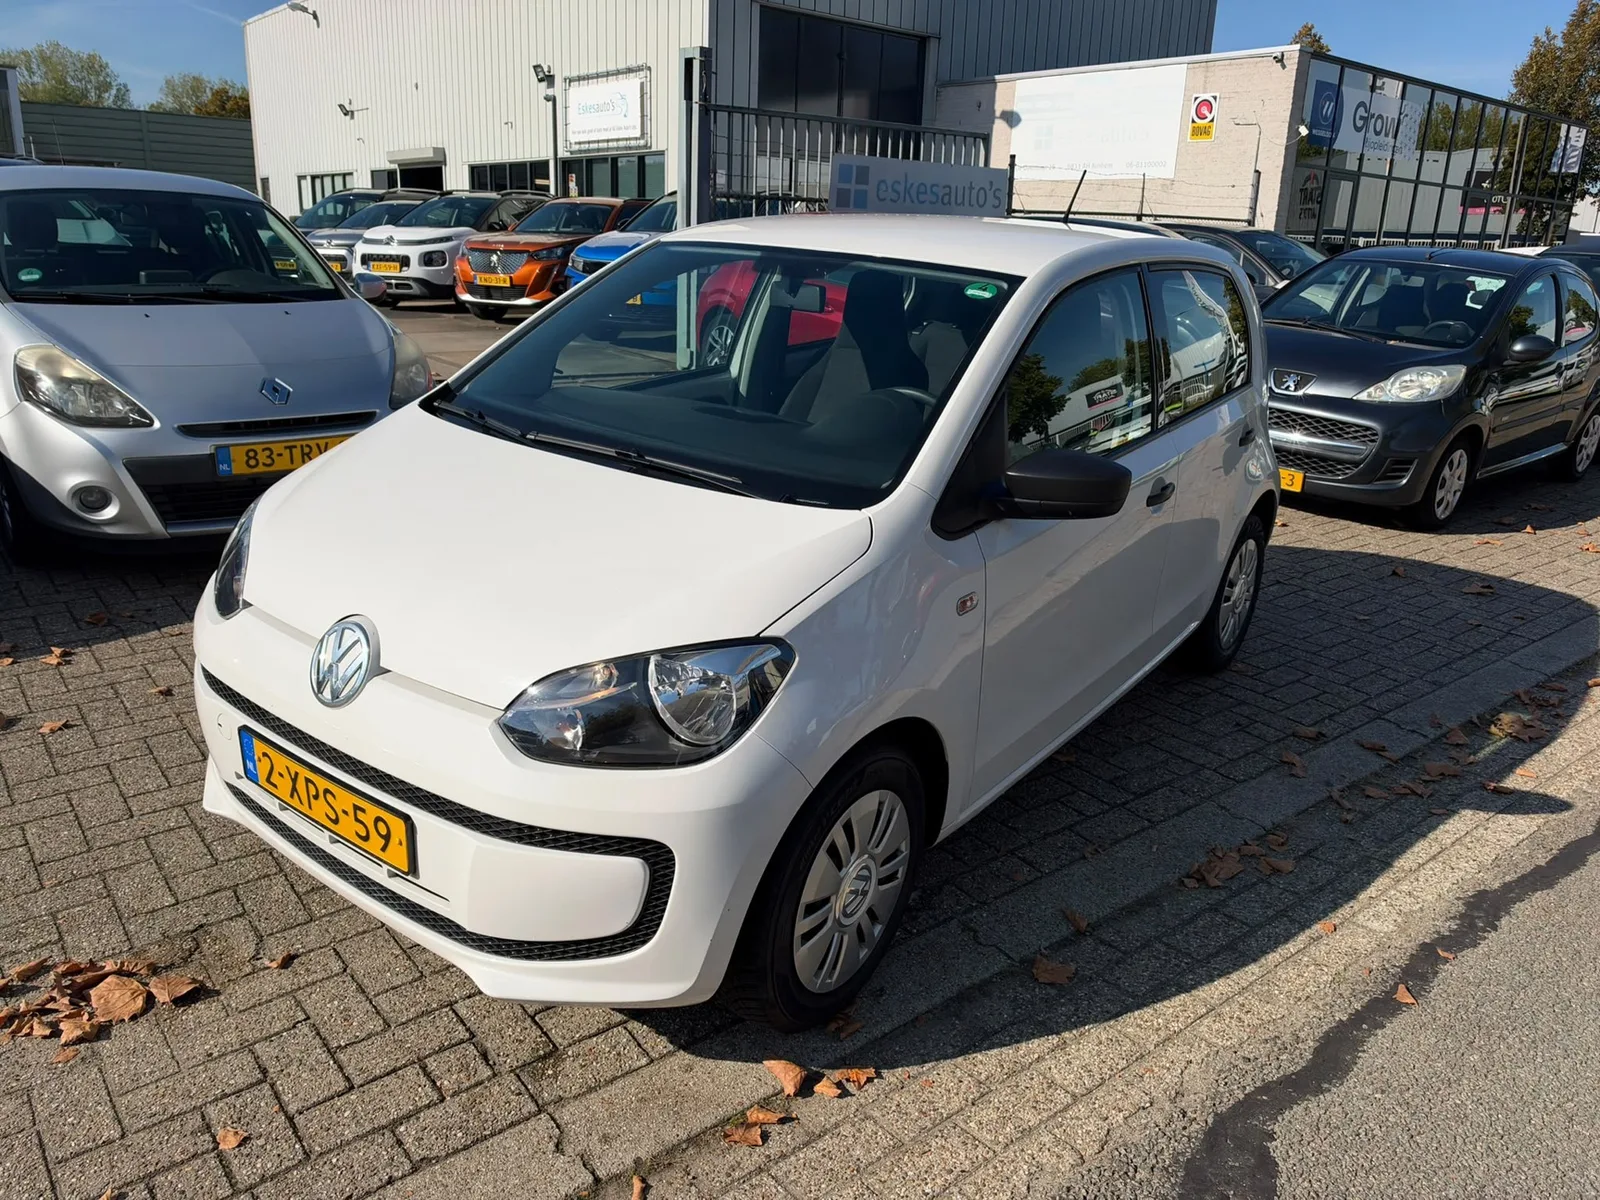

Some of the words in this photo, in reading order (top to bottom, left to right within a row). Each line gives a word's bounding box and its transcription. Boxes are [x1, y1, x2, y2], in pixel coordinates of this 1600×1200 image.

[1191, 125, 1212, 137] BOVAG
[875, 172, 1003, 209] eskesauto's
[261, 751, 392, 853] 2-XPS-59
